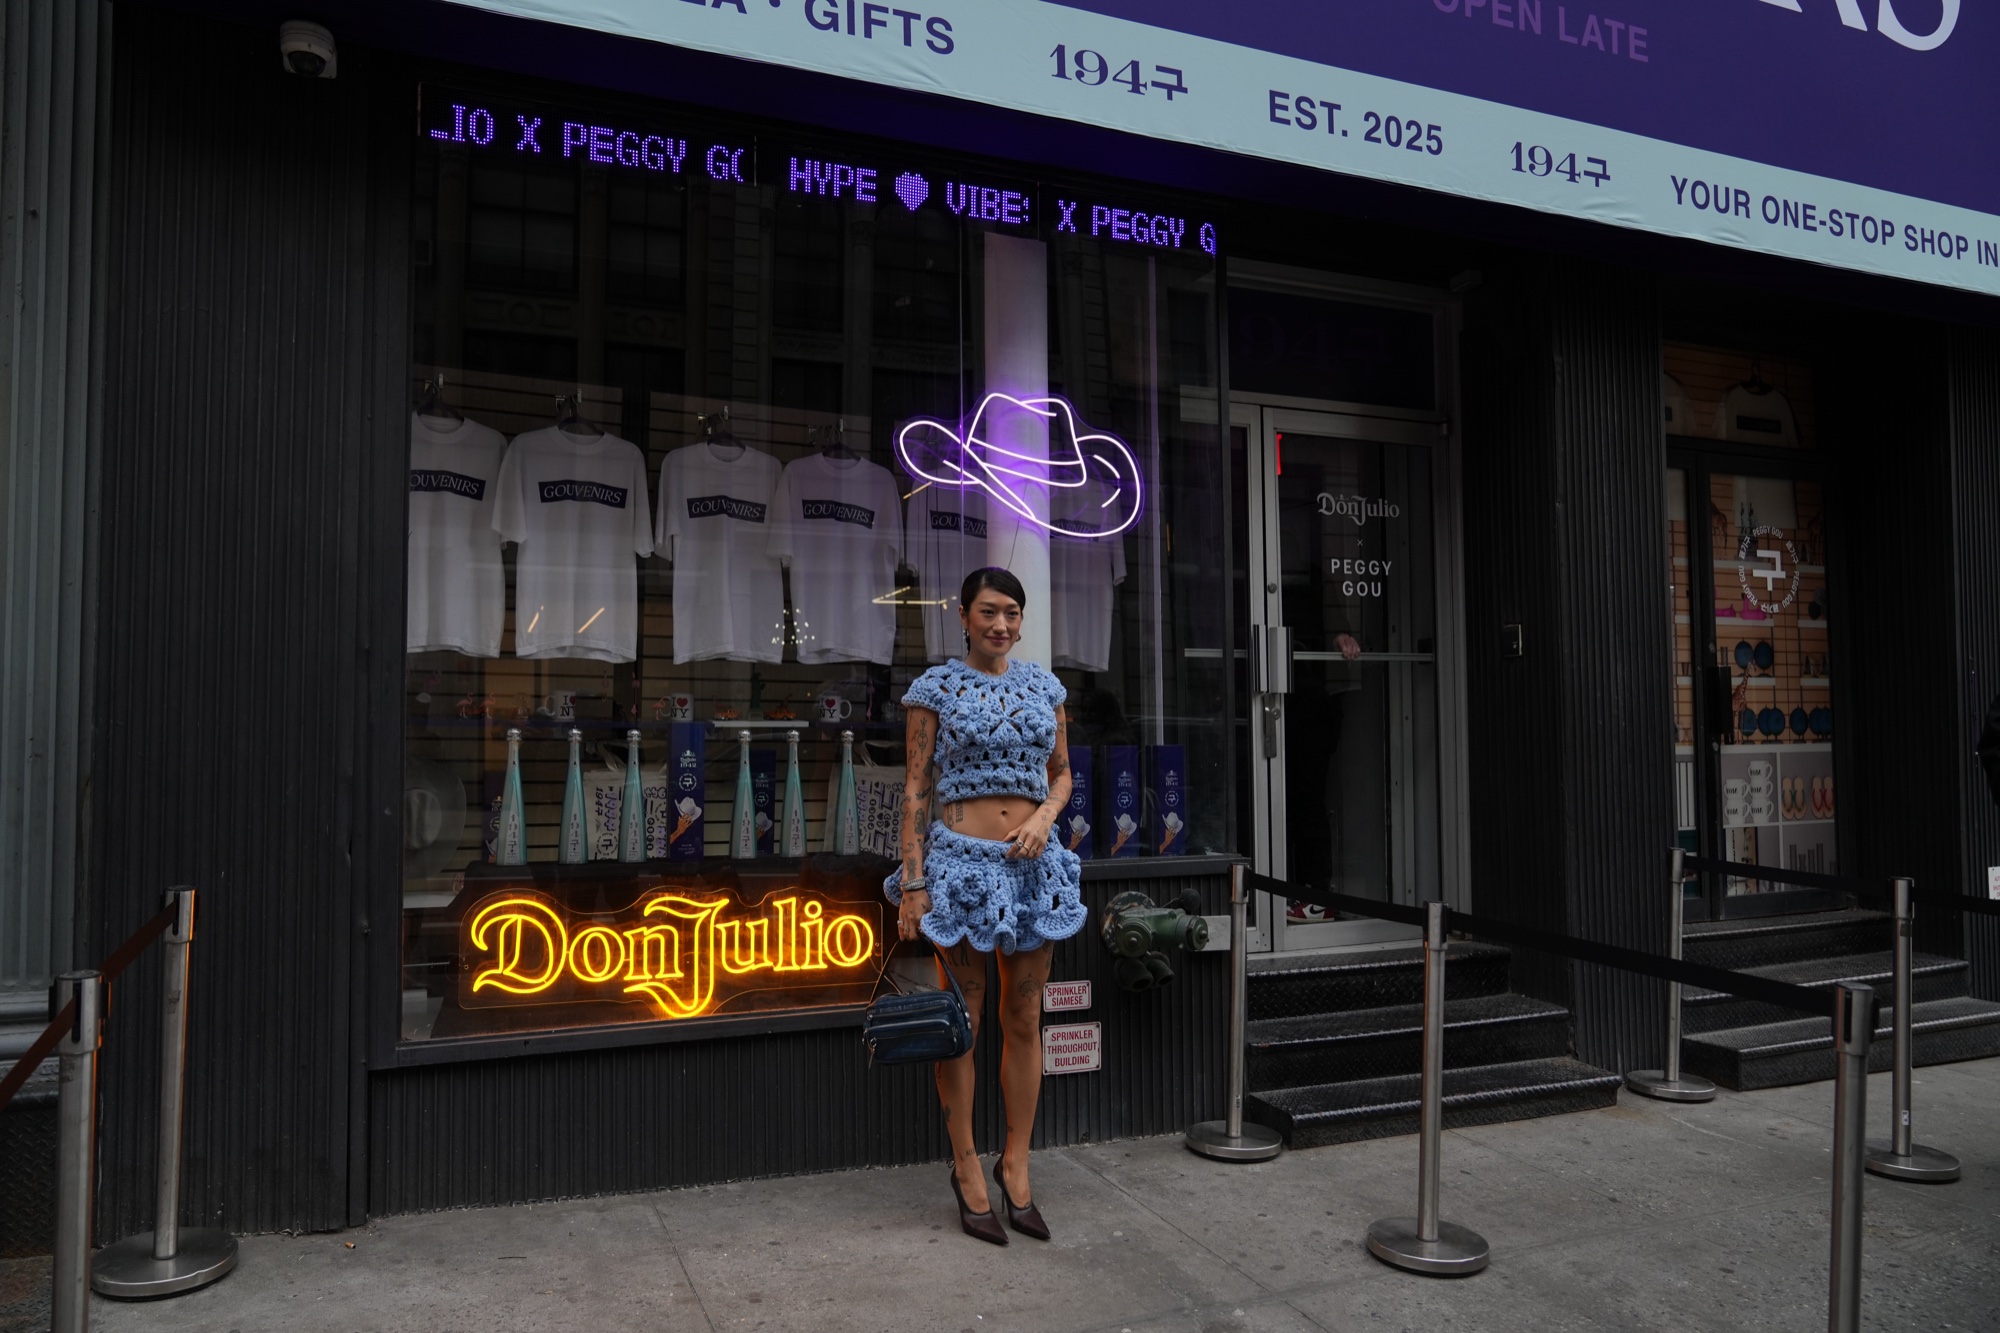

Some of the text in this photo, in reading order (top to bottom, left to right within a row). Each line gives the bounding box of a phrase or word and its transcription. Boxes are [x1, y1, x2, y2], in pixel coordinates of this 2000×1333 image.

[804, 0, 955, 55] GIFTS
[1558, 6, 1649, 63] LATE
[1268, 89, 1443, 156] EST. 2025
[517, 115, 541, 153] X
[563, 121, 686, 173] PEGGY
[790, 157, 1029, 224] HYPE VIBE
[1058, 199, 1076, 233] X
[1092, 205, 1184, 248] PEGGY
[1670, 174, 1999, 268] YOUR ONE-STOP SHOP IN
[409, 474, 480, 495] OUVENIRS
[543, 484, 623, 504] GOUVENIRS
[691, 499, 762, 519] GOUVENIRS
[803, 503, 871, 523] GOUVENIRS
[931, 514, 987, 536] GOUVENIR
[1752, 525, 1784, 540] PEGGY GOU
[1331, 558, 1392, 576] PEGGY
[1342, 581, 1382, 597] GOU
[1738, 565, 1758, 606] PEGGY GOU
[1781, 570, 1800, 608] PEGGY GOU
[670, 708, 690, 718] NY
[819, 708, 837, 719] NY
[1047, 985, 1087, 997] SPRINKLER
[1051, 996, 1083, 1007] SIAMESE
[1051, 1029, 1093, 1042] SPRINKLER
[1047, 1041, 1098, 1055] THROUGHOUT
[1054, 1054, 1090, 1067] BUILDING
